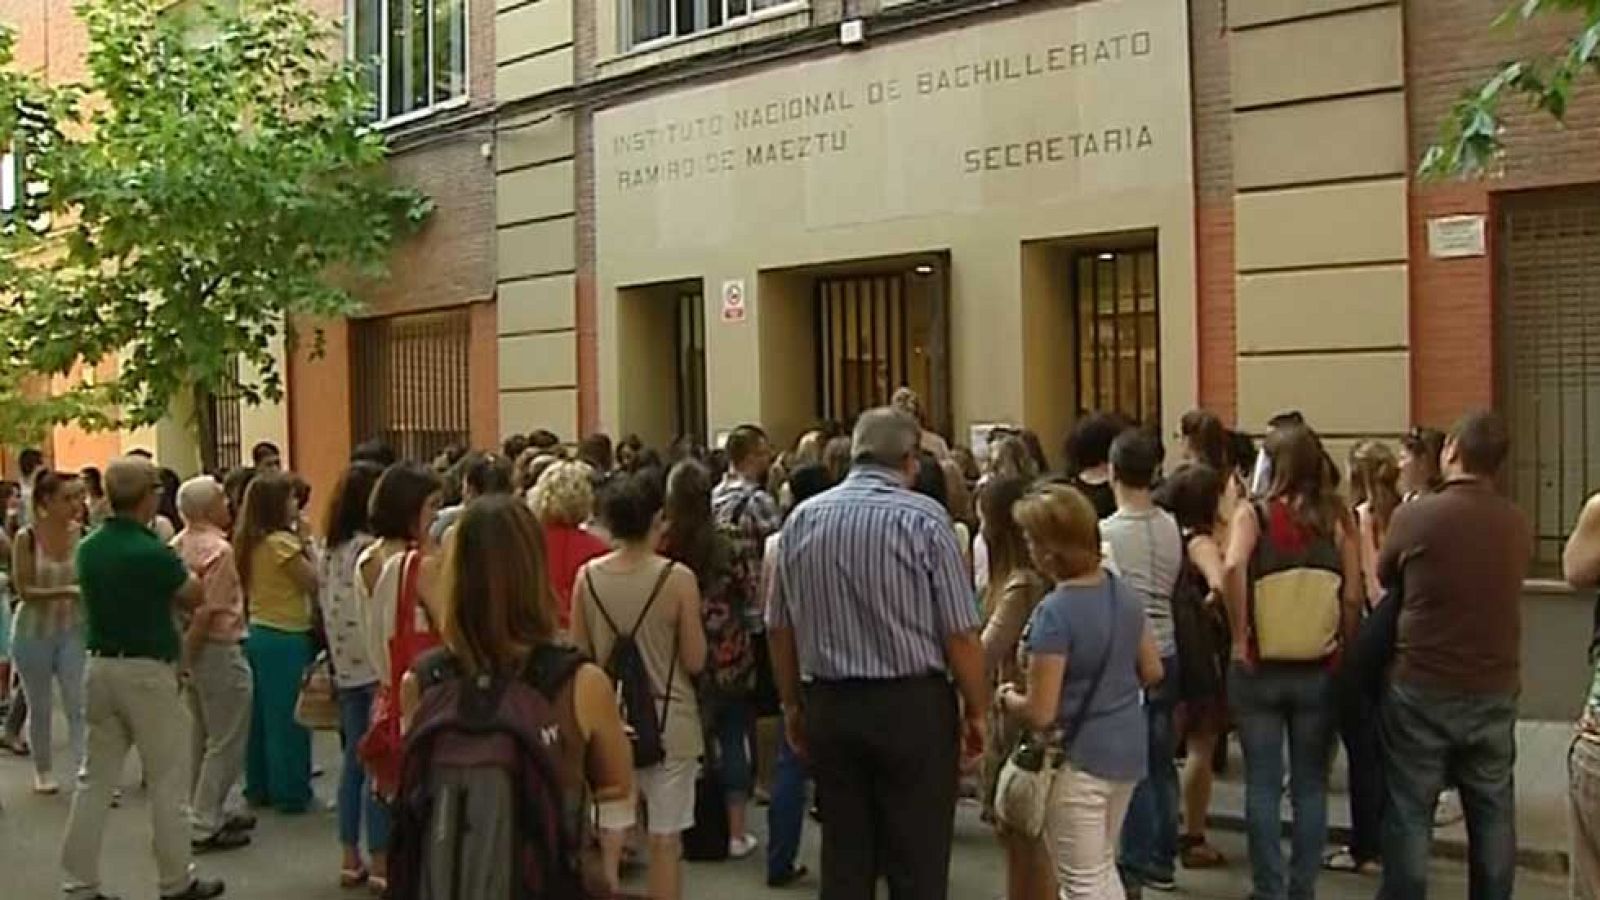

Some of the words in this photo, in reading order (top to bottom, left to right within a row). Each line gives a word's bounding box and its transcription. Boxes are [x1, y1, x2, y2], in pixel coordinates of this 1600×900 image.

[613, 115, 723, 154] INSTITUTO
[734, 89, 854, 131] NACIONAL
[867, 80, 902, 104] DE
[917, 31, 1151, 95] BACHILLERATO
[617, 157, 695, 190] RAMIRO
[706, 149, 734, 174] DE
[745, 130, 847, 167] MAEZTU
[964, 125, 1153, 173] SECRETARIA
